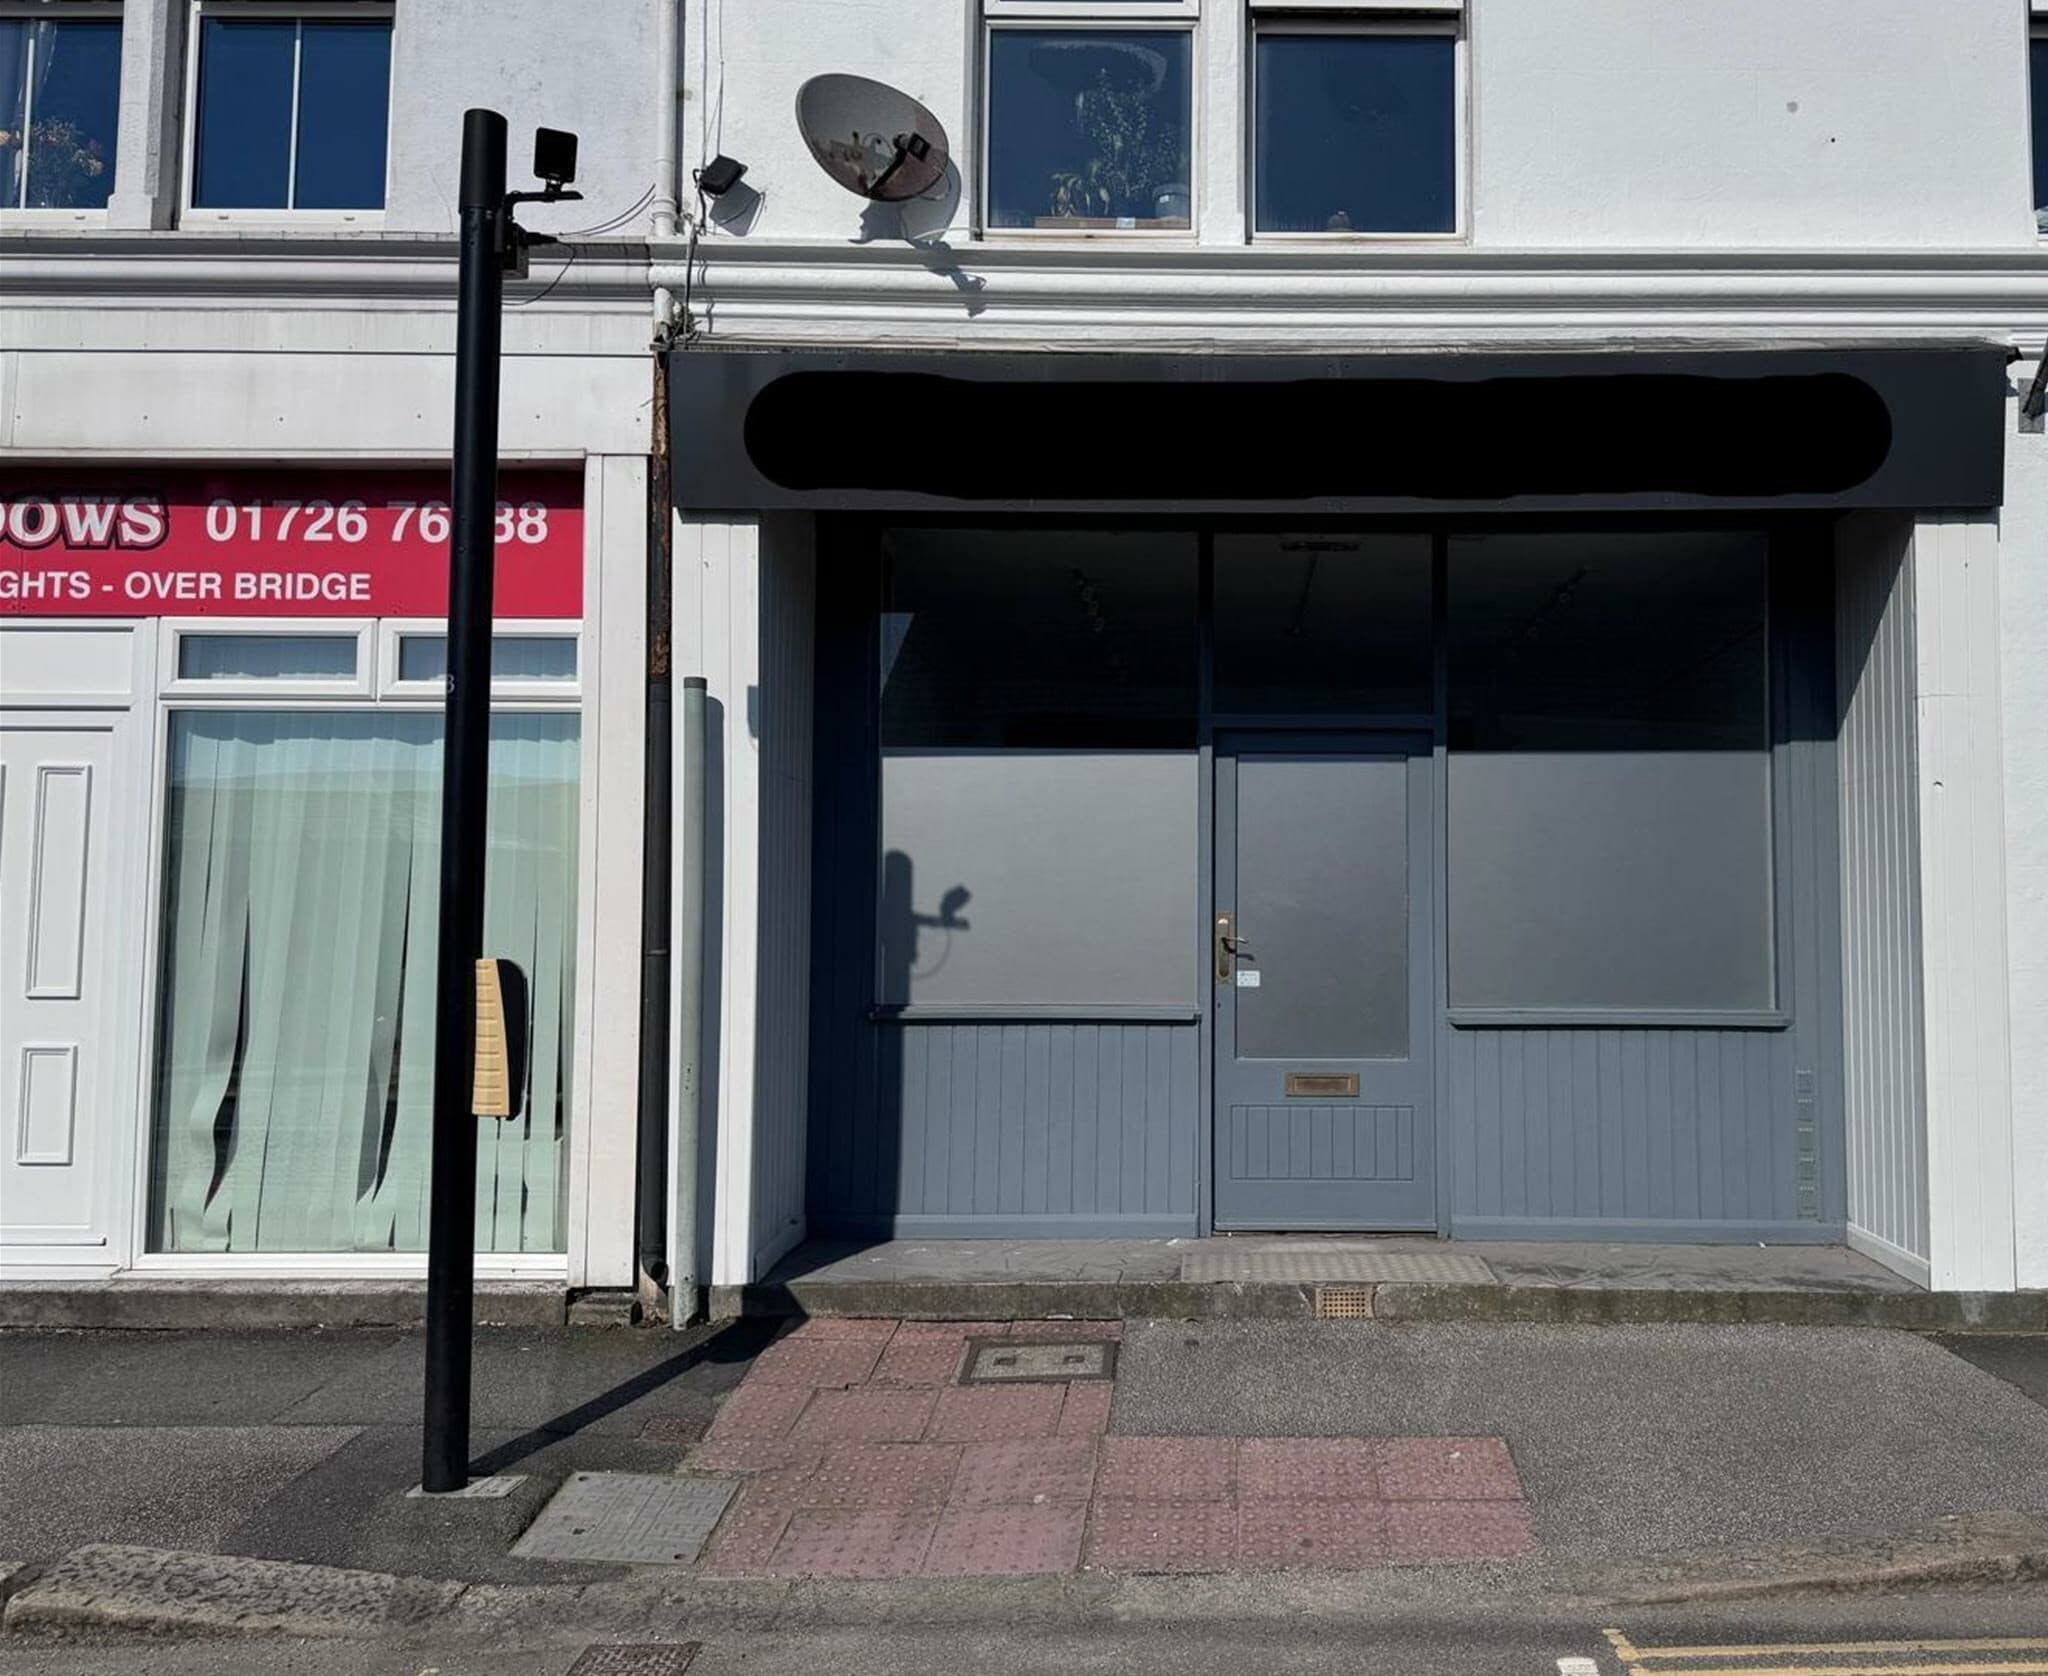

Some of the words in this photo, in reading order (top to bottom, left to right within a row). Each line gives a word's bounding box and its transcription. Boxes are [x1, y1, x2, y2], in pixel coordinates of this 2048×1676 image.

[0, 495, 166, 548] OWS
[206, 499, 369, 543] 01726
[387, 500, 549, 544] 7688
[0, 571, 91, 599] GHTS
[124, 571, 222, 599] OVER
[234, 572, 371, 600] BRIDGE
